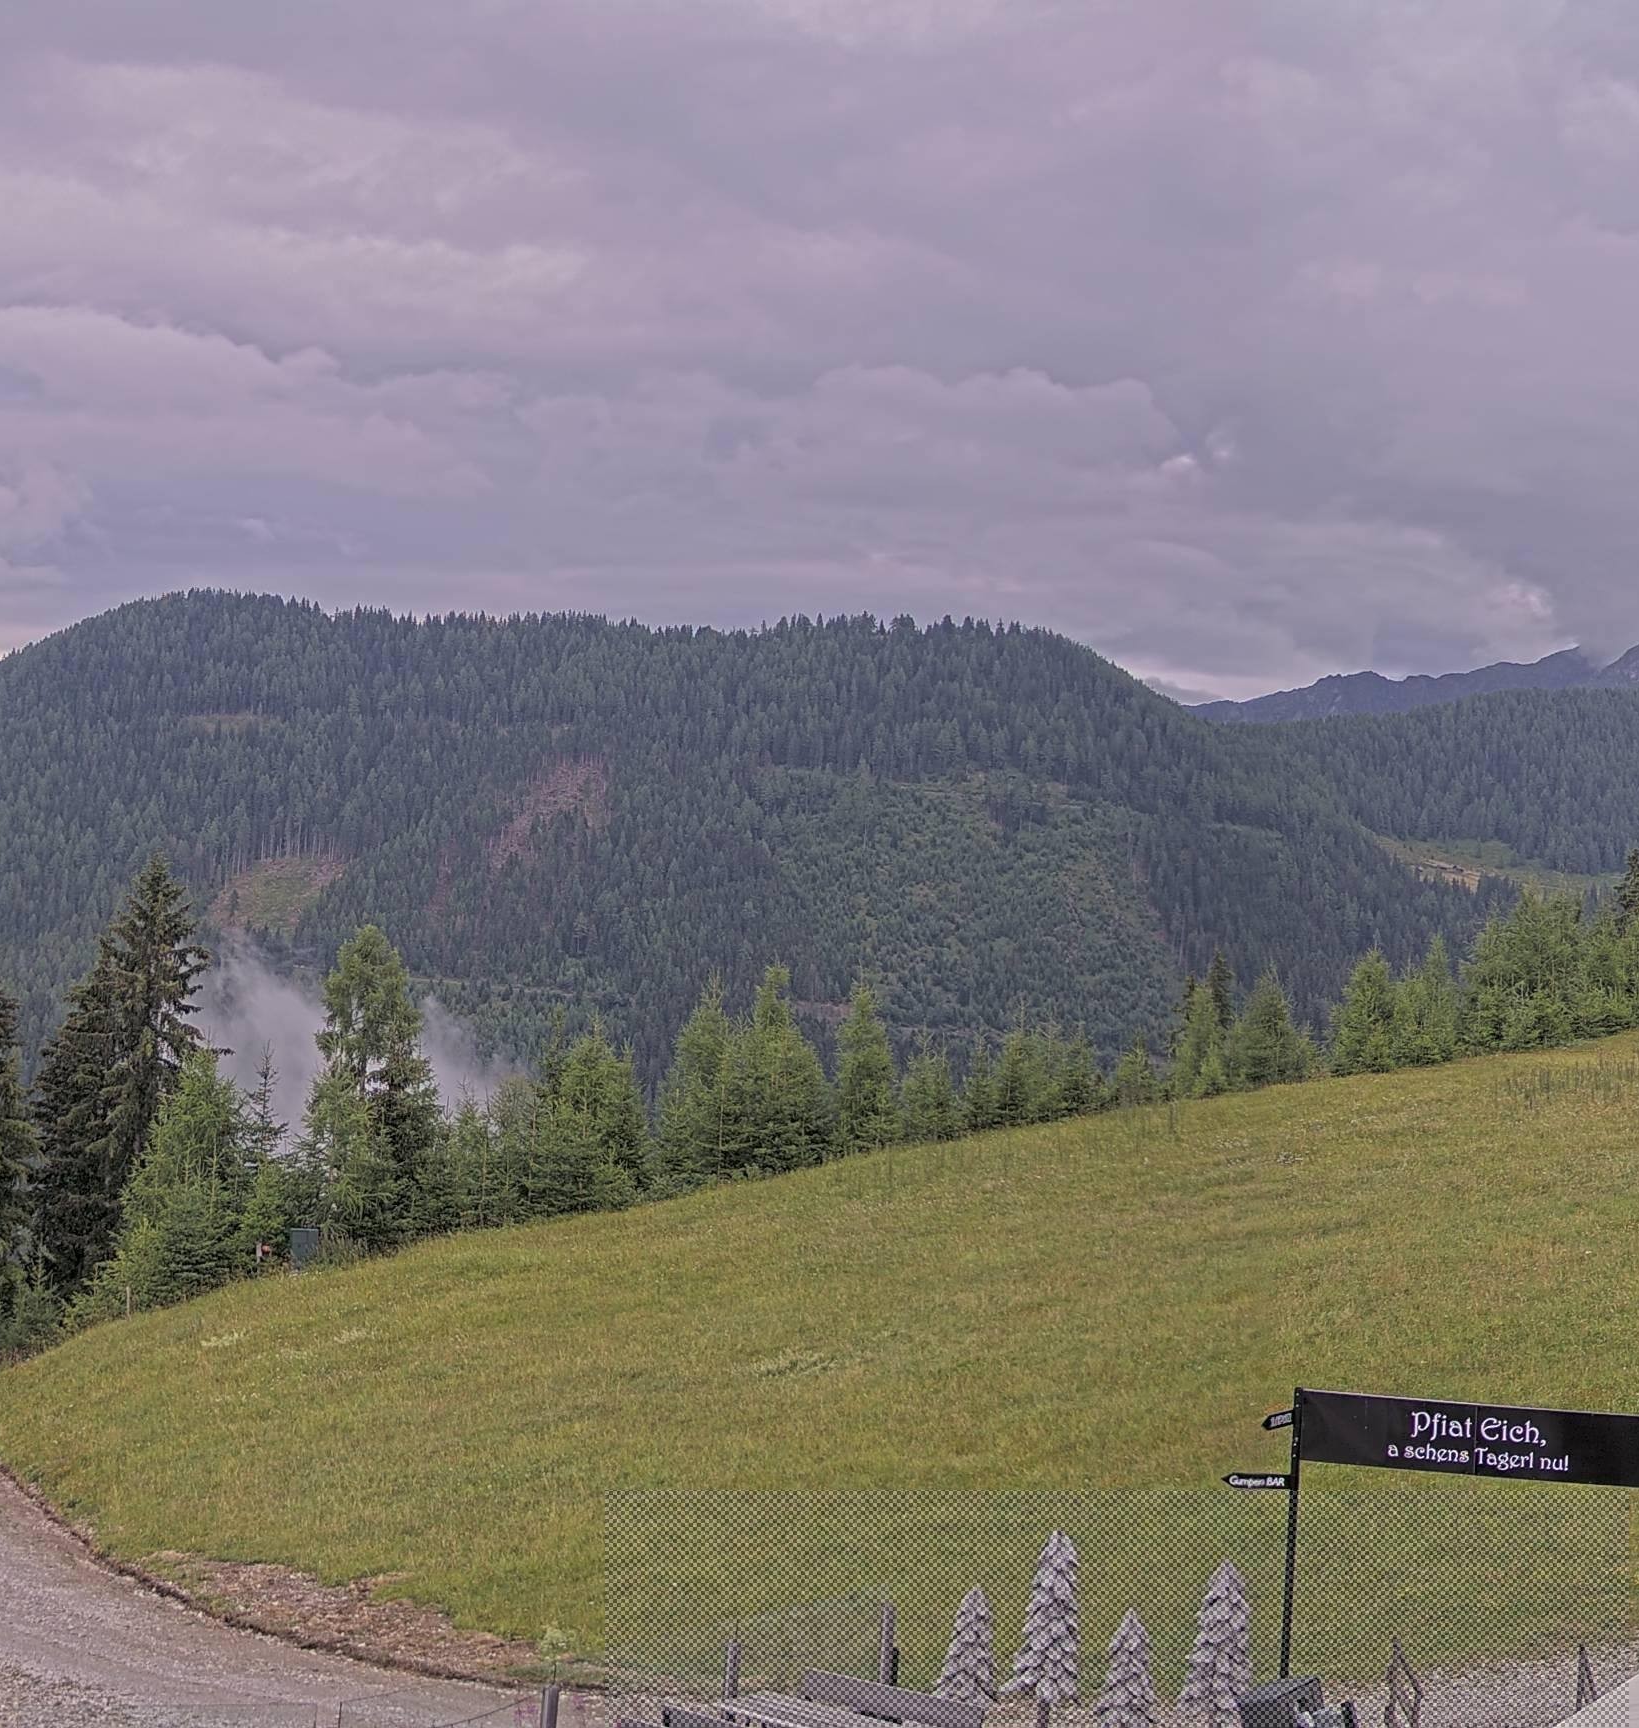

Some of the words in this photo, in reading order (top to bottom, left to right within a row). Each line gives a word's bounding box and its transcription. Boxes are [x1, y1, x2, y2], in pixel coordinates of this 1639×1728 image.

[1410, 1411, 1473, 1441] Pfiat
[1480, 1417, 1547, 1447] Eich,
[1387, 1444, 1399, 1457] a
[1403, 1443, 1470, 1463] schens
[1475, 1447, 1534, 1471] Tagerl
[1539, 1455, 1569, 1472] nu!
[1266, 1476, 1285, 1487] BAR
